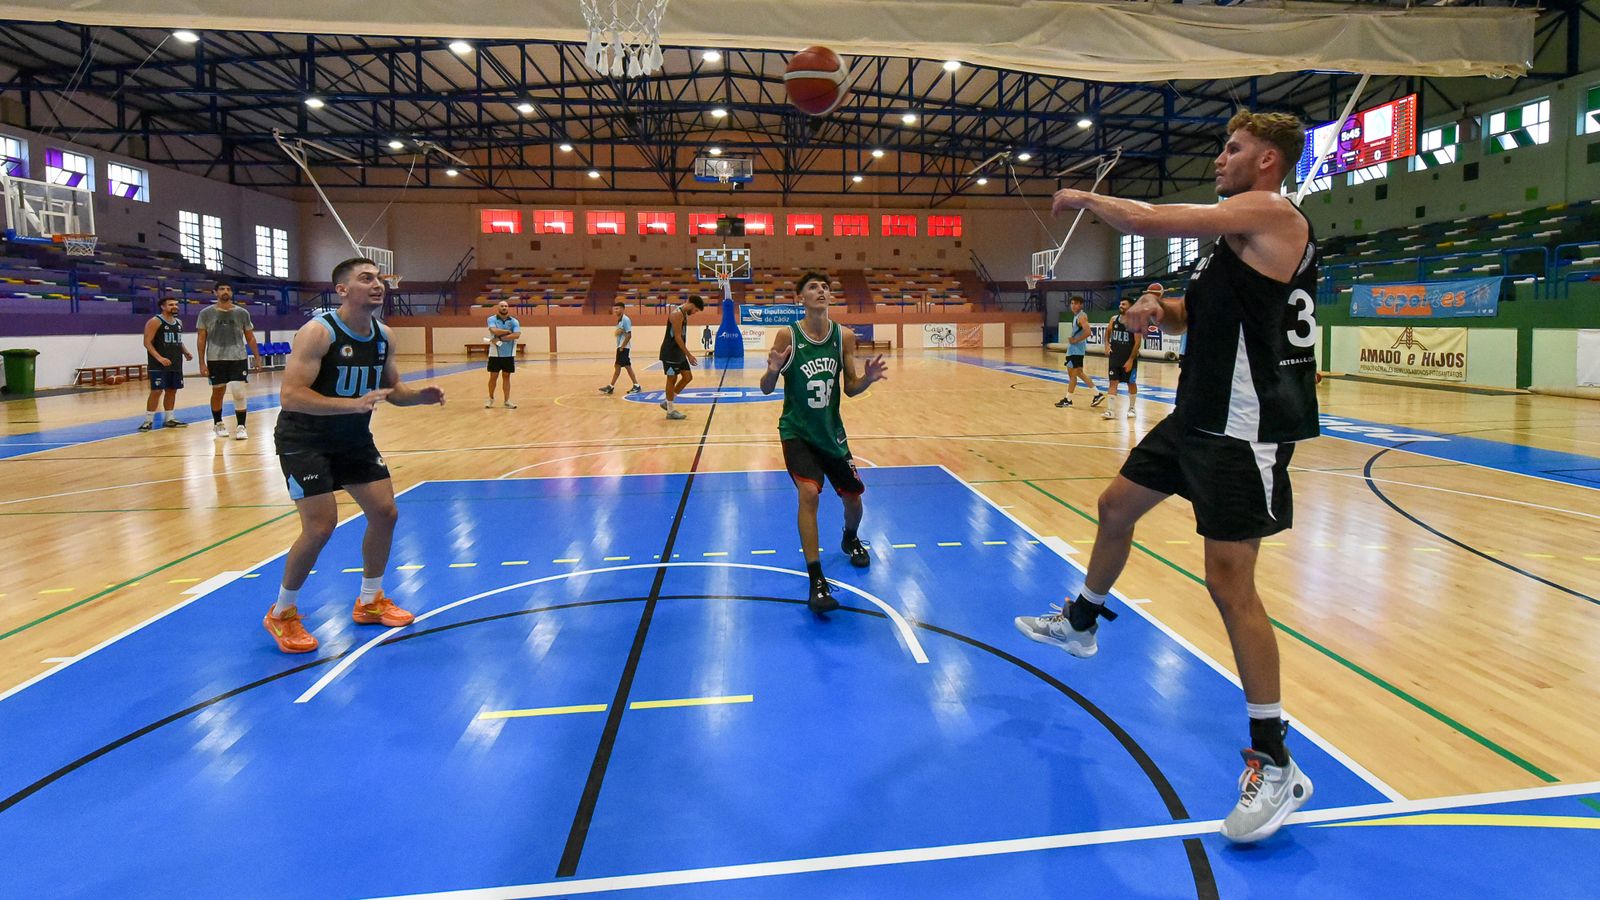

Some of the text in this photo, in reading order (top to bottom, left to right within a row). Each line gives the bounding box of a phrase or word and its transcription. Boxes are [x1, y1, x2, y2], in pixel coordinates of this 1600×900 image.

[1374, 149, 1382, 161] 0
[1322, 163, 1329, 174] 0
[1286, 288, 1317, 348] 3
[799, 357, 838, 379] BOSTON
[1360, 348, 1465, 369] AMADO e HIJOS
